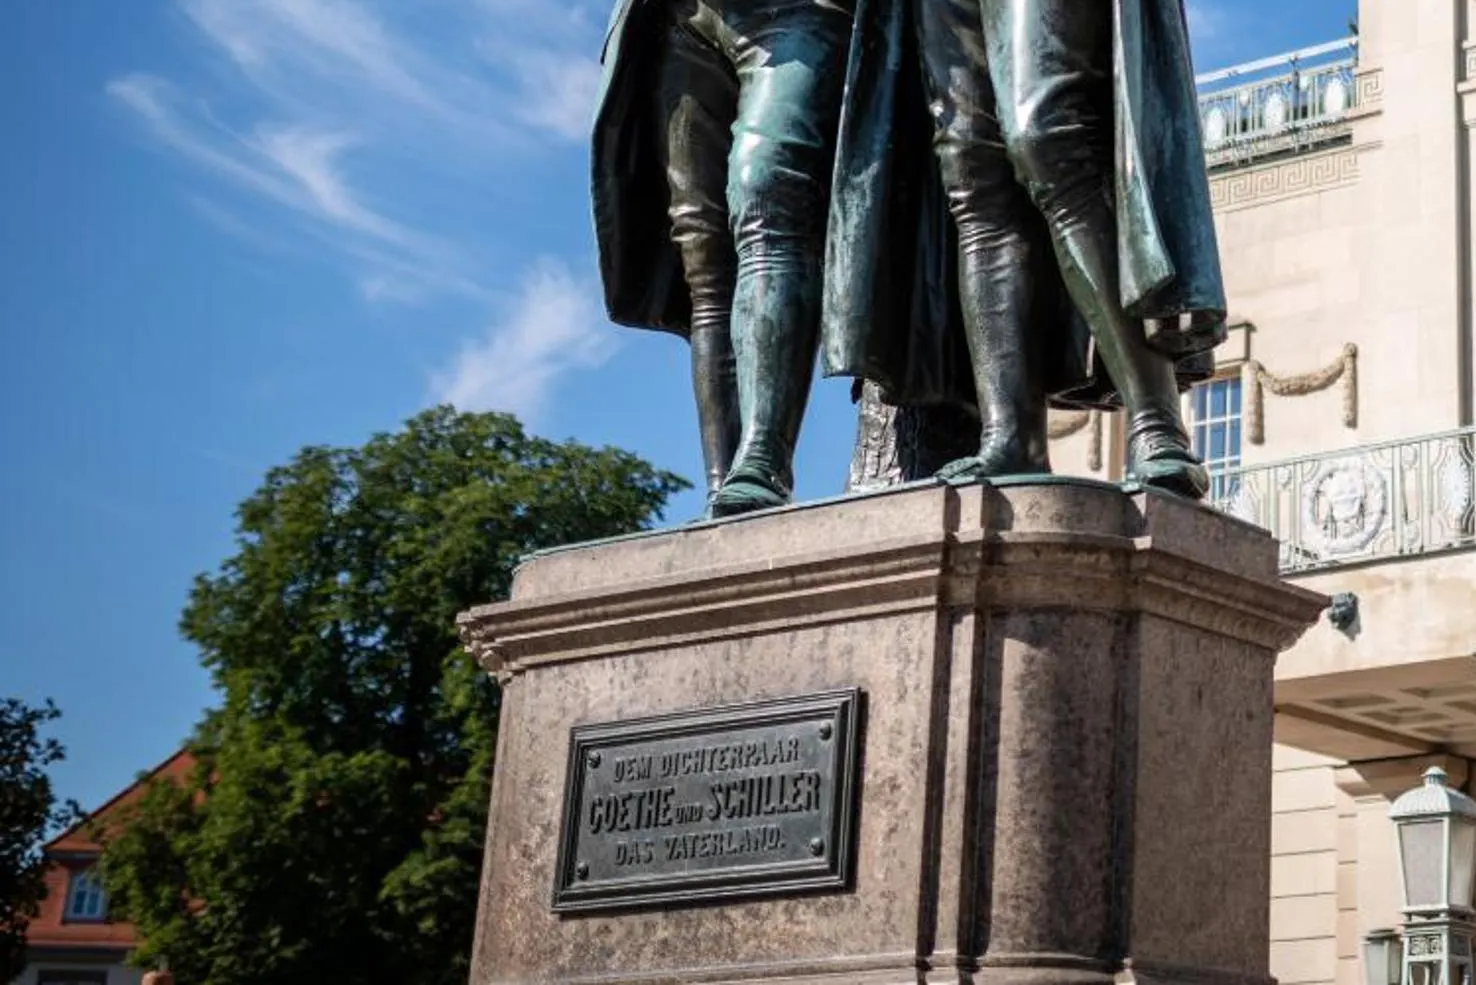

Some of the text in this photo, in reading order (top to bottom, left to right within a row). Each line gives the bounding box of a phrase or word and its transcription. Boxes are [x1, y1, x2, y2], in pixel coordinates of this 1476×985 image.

[614, 737, 799, 782] DEM DICHTERPAAR
[589, 786, 675, 834] GOETHE
[708, 770, 821, 821] SCHILLER
[615, 840, 654, 866] DAS
